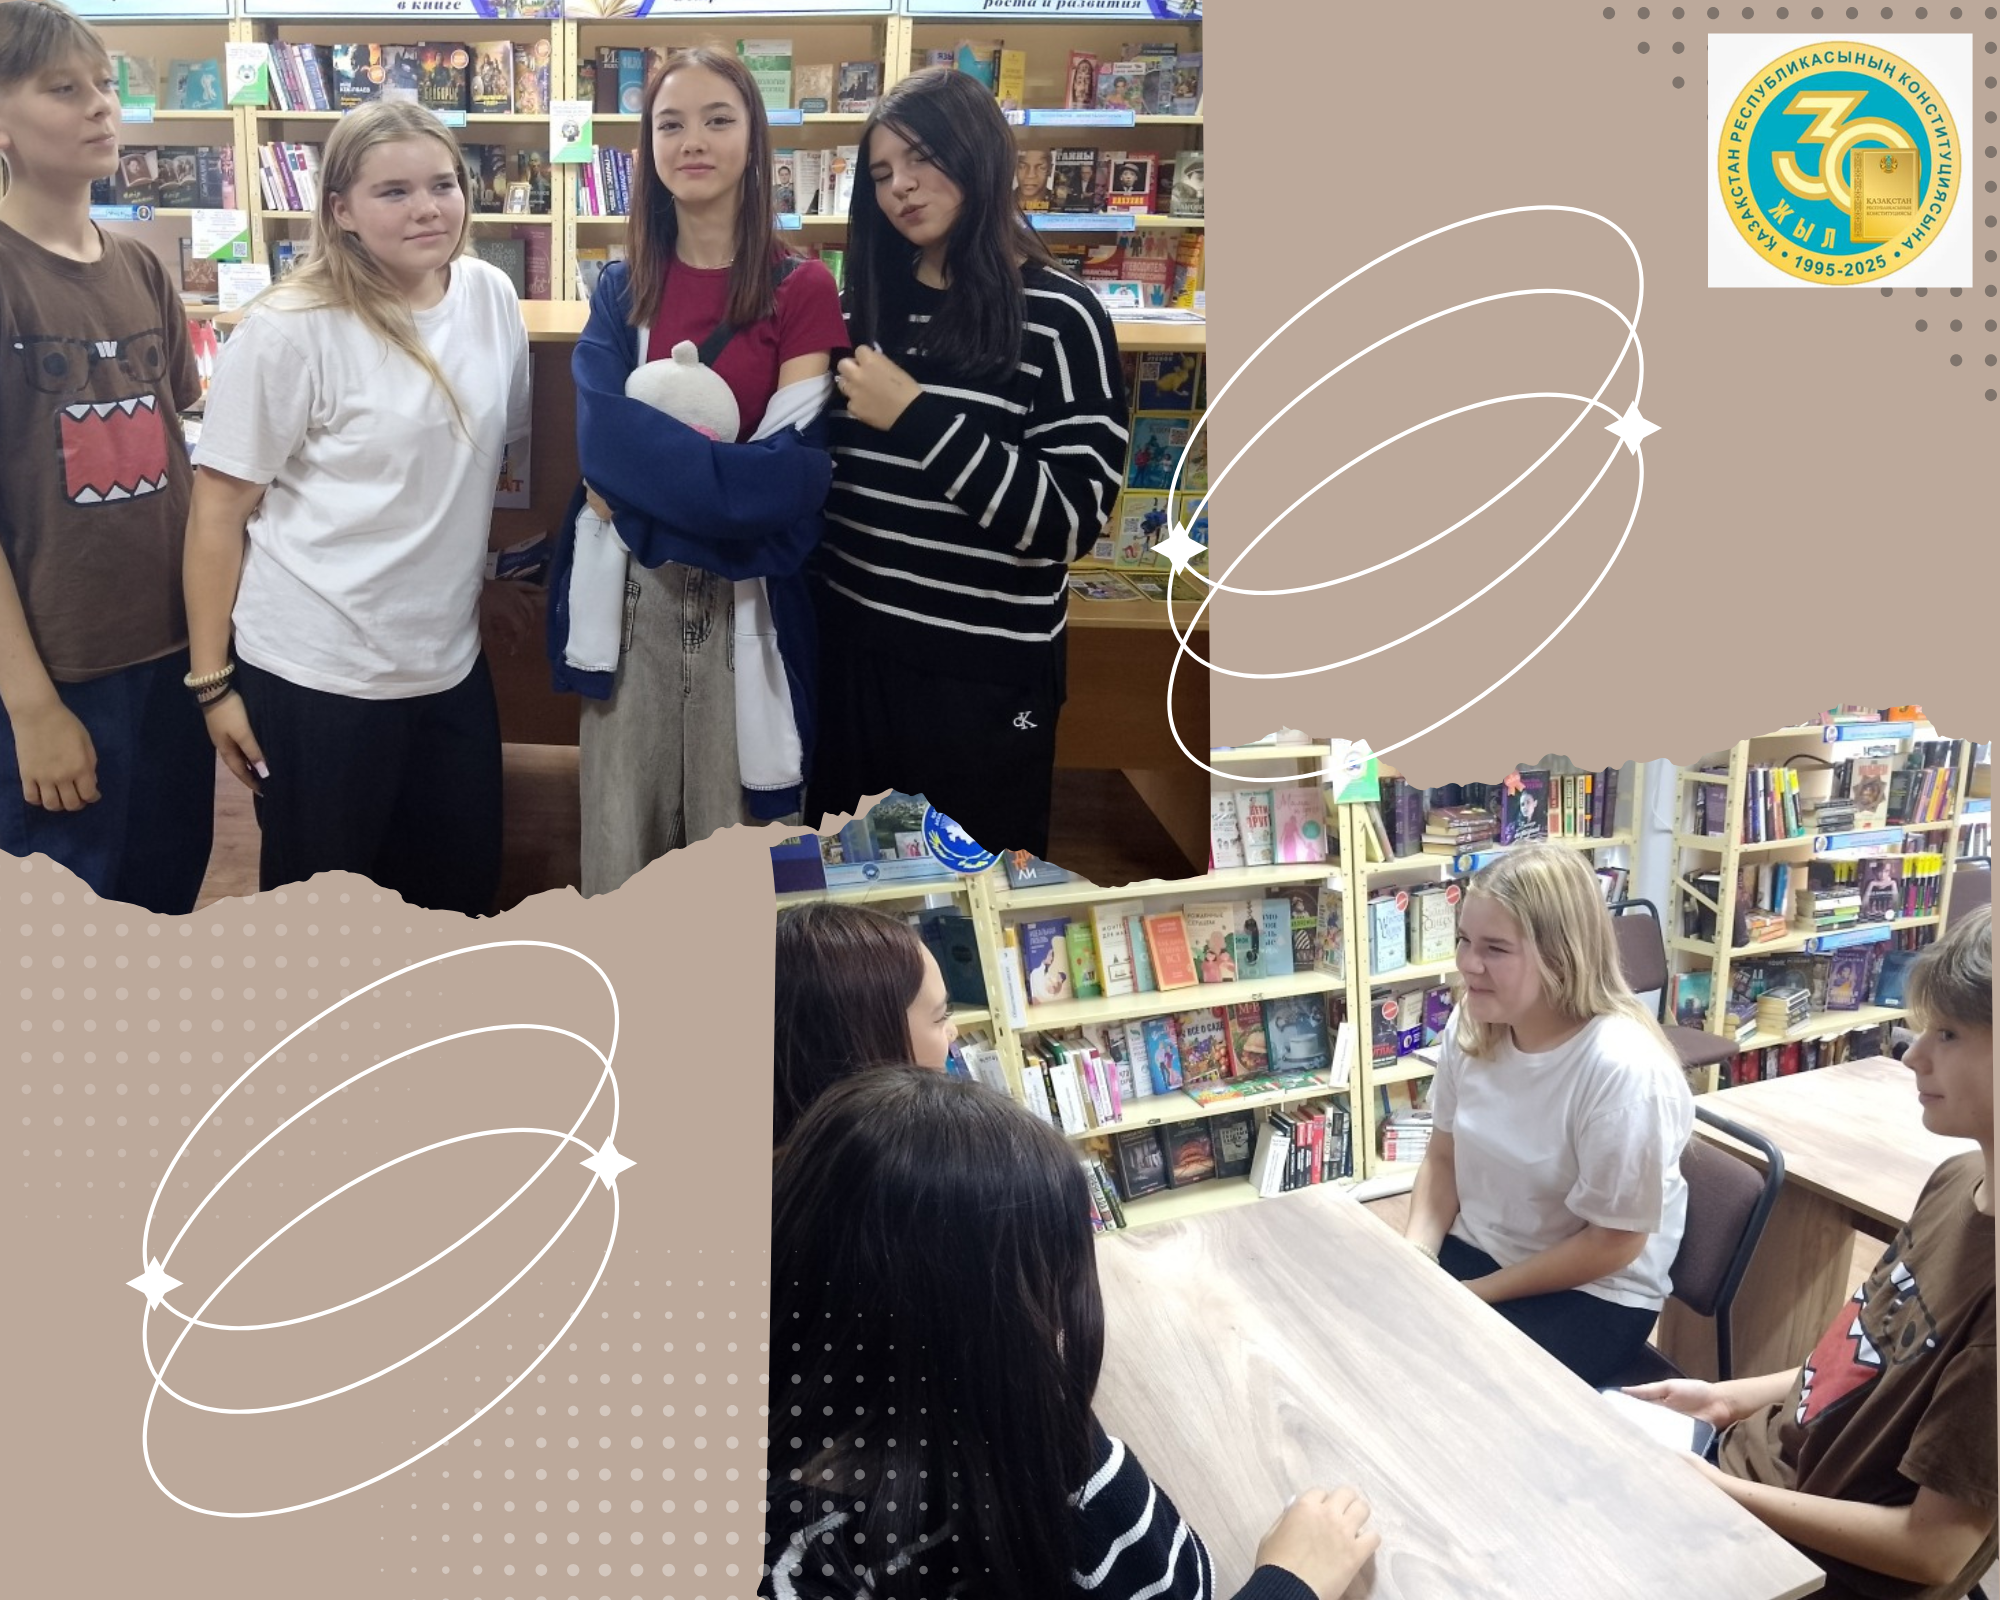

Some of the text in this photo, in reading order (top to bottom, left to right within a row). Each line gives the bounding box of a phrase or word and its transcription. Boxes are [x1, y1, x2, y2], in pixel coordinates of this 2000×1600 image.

[411, 0, 462, 10] книге
[982, 0, 1037, 10] роста
[1056, 0, 1142, 10] развития
